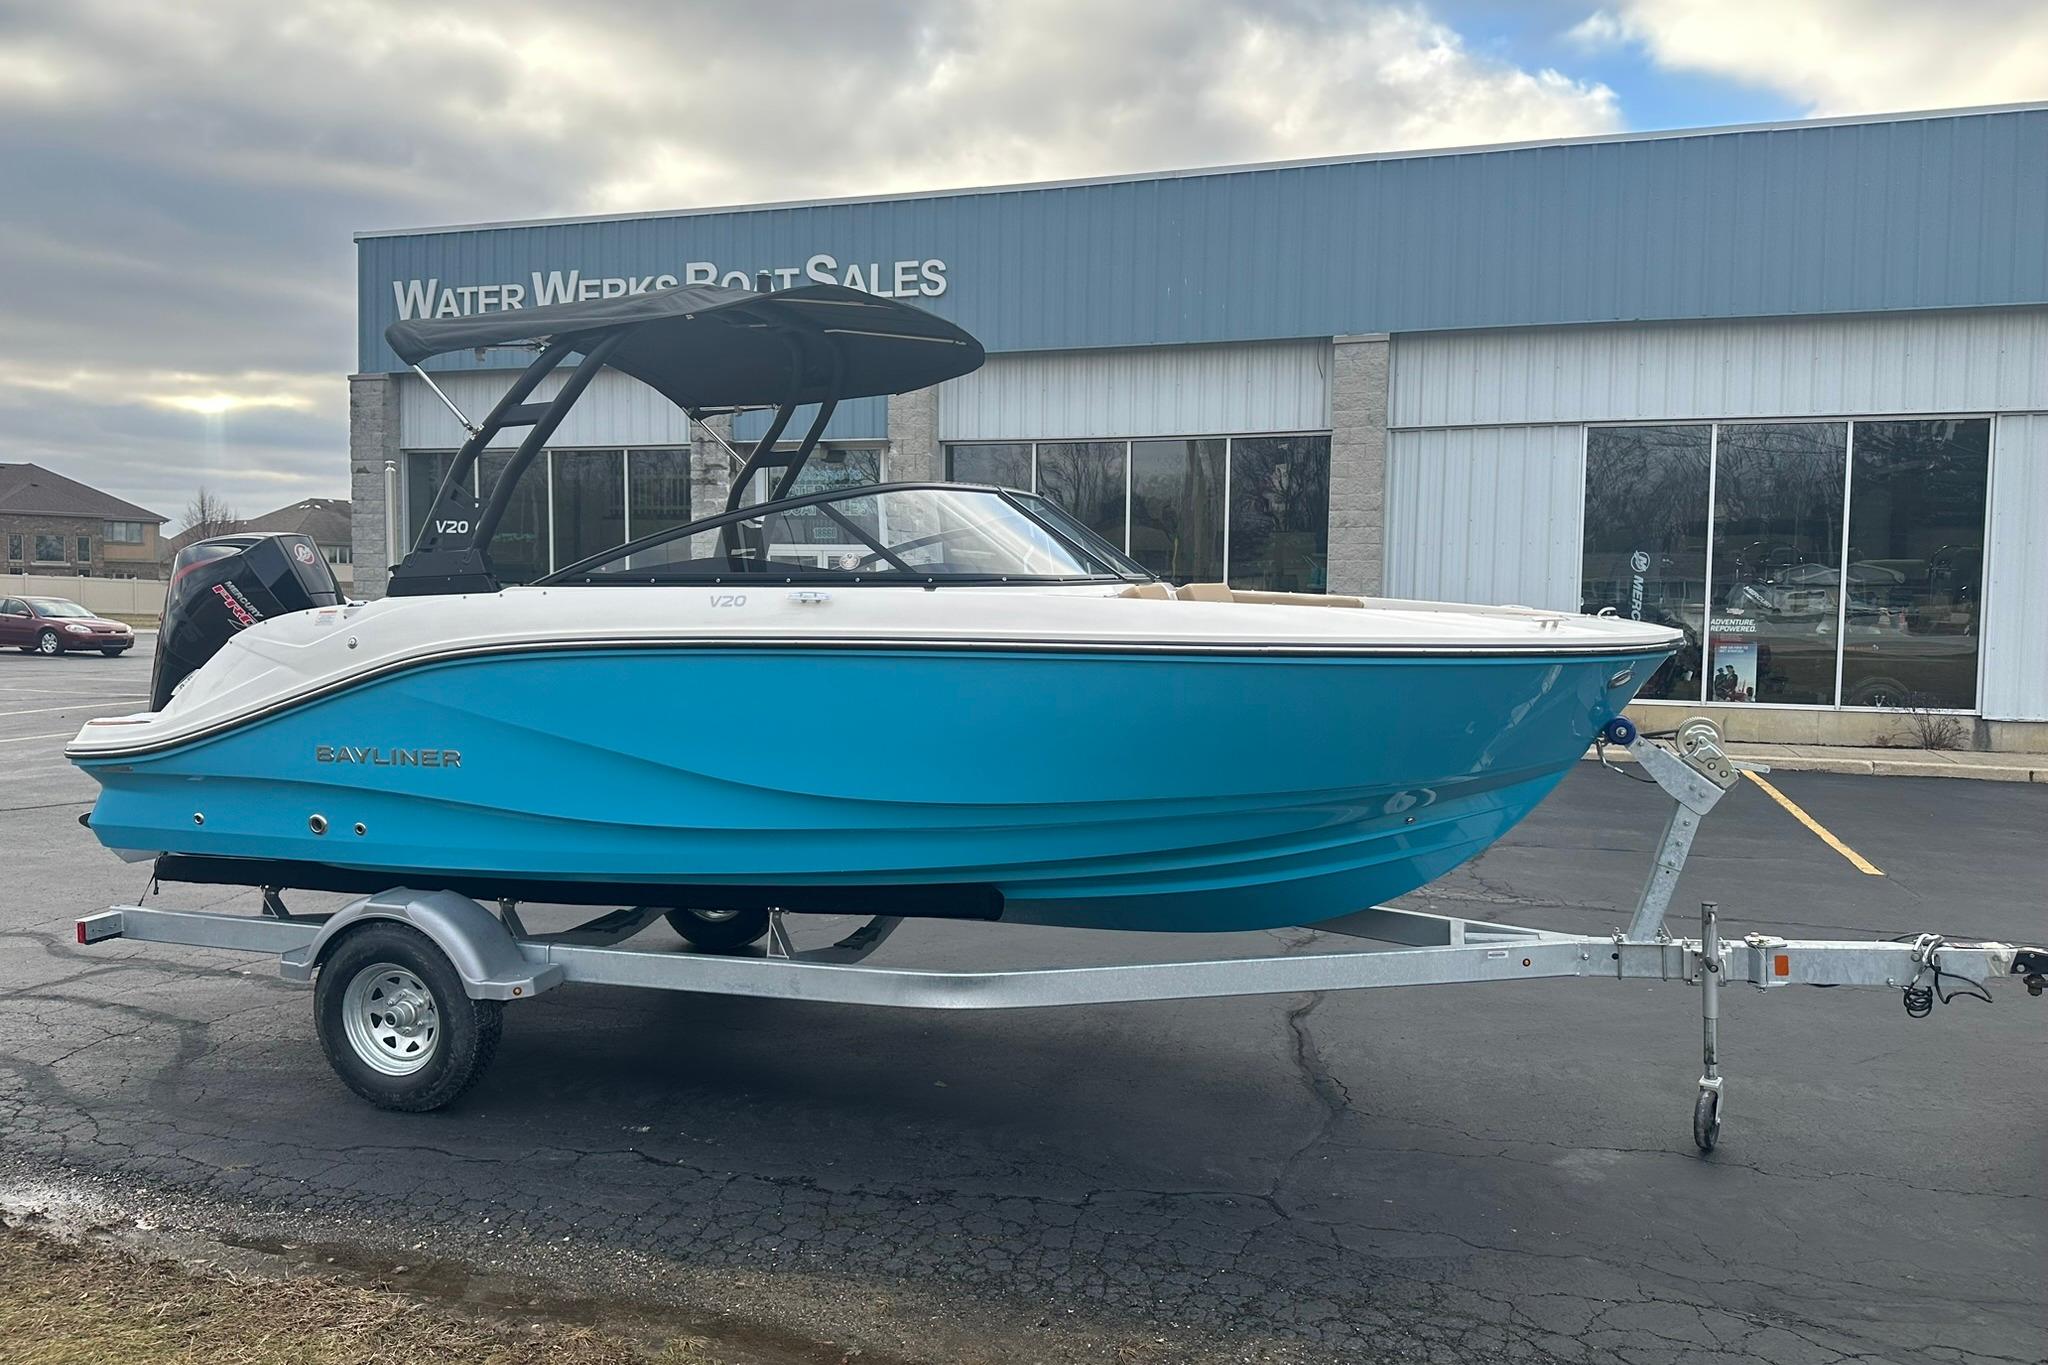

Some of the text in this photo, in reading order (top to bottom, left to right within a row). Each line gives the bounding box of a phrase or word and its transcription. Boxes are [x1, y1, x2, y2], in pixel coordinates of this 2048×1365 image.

[393, 278, 525, 320] WATER
[806, 254, 948, 298] SALES
[436, 520, 469, 534] V20
[224, 580, 264, 618] MERCURY
[710, 595, 747, 608] V20
[316, 744, 461, 768] BAYLINER
